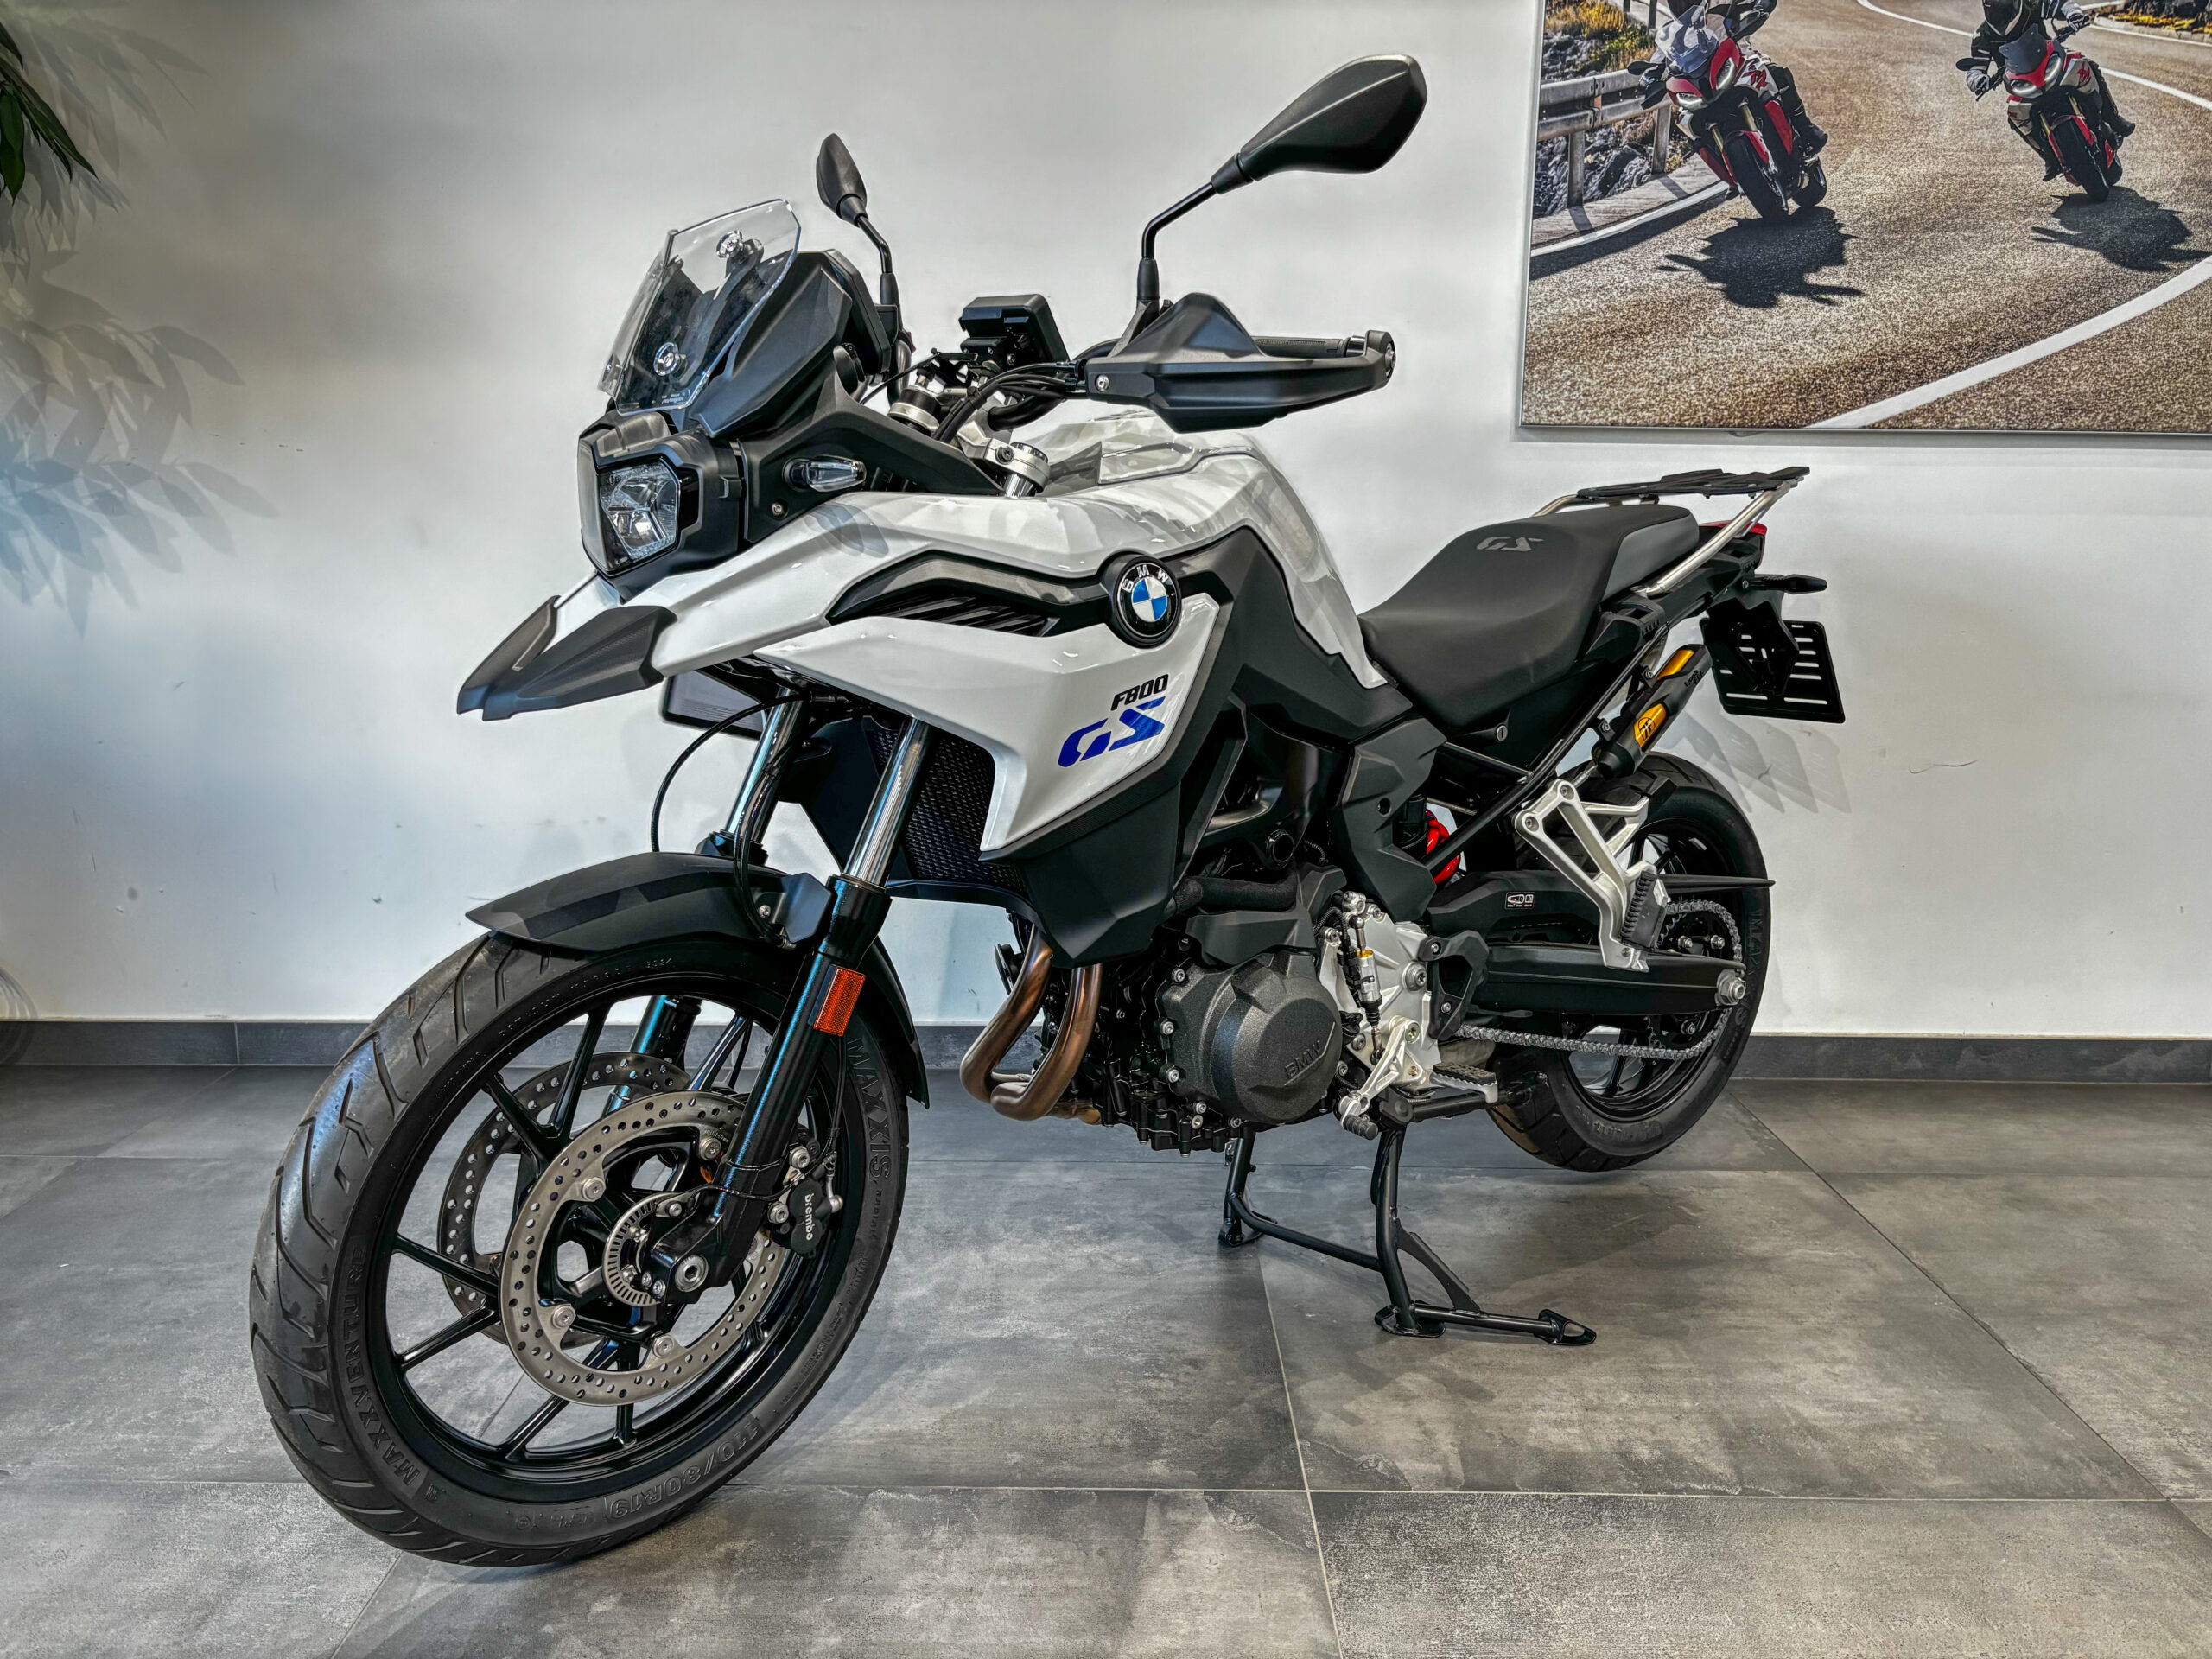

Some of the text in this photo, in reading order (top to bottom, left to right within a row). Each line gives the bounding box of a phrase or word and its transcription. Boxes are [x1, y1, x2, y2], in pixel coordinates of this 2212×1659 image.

[1476, 536, 1544, 551] GS
[1122, 564, 1169, 593] BMW
[1111, 673, 1168, 711] F800
[1058, 696, 1166, 768] GS
[1284, 1039, 1320, 1079] BMW
[845, 1038, 892, 1179] MAXXIS
[804, 1192, 815, 1241] brembo
[610, 1422, 759, 1520] 110/80R19
